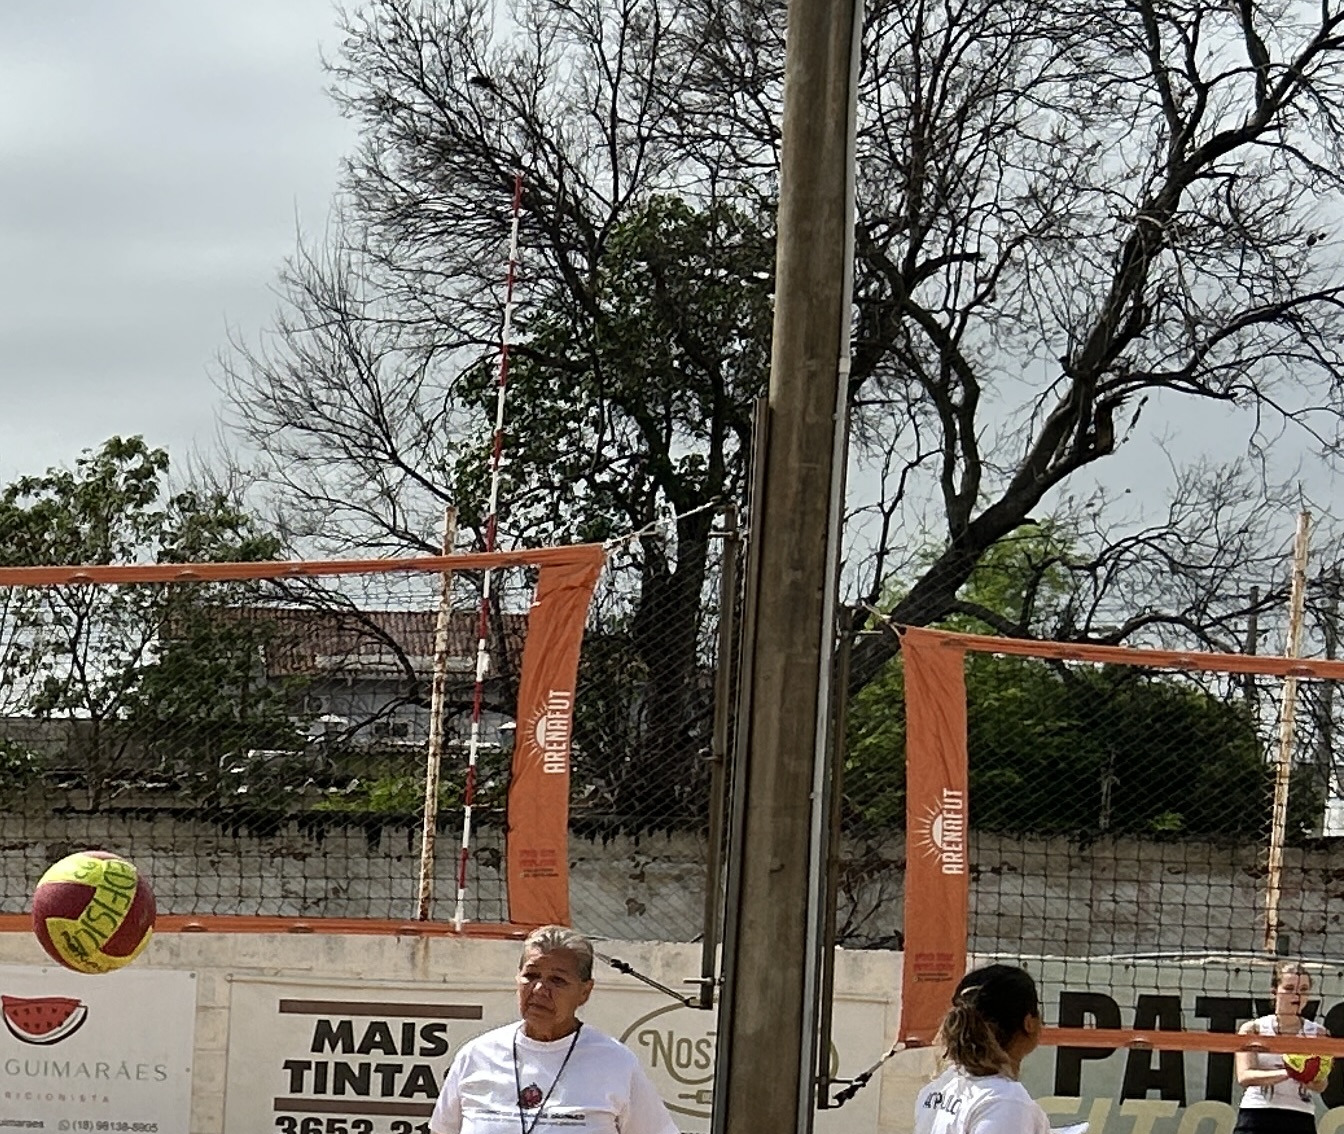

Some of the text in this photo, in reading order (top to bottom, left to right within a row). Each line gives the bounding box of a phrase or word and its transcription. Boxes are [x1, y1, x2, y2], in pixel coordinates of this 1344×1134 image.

[543, 689, 572, 774] ARENAFUT
[942, 787, 964, 875] ARENAFUT
[310, 1019, 450, 1058] MAIS
[4, 1057, 168, 1083] GUIMARÃES
[282, 1059, 453, 1099] TINTA
